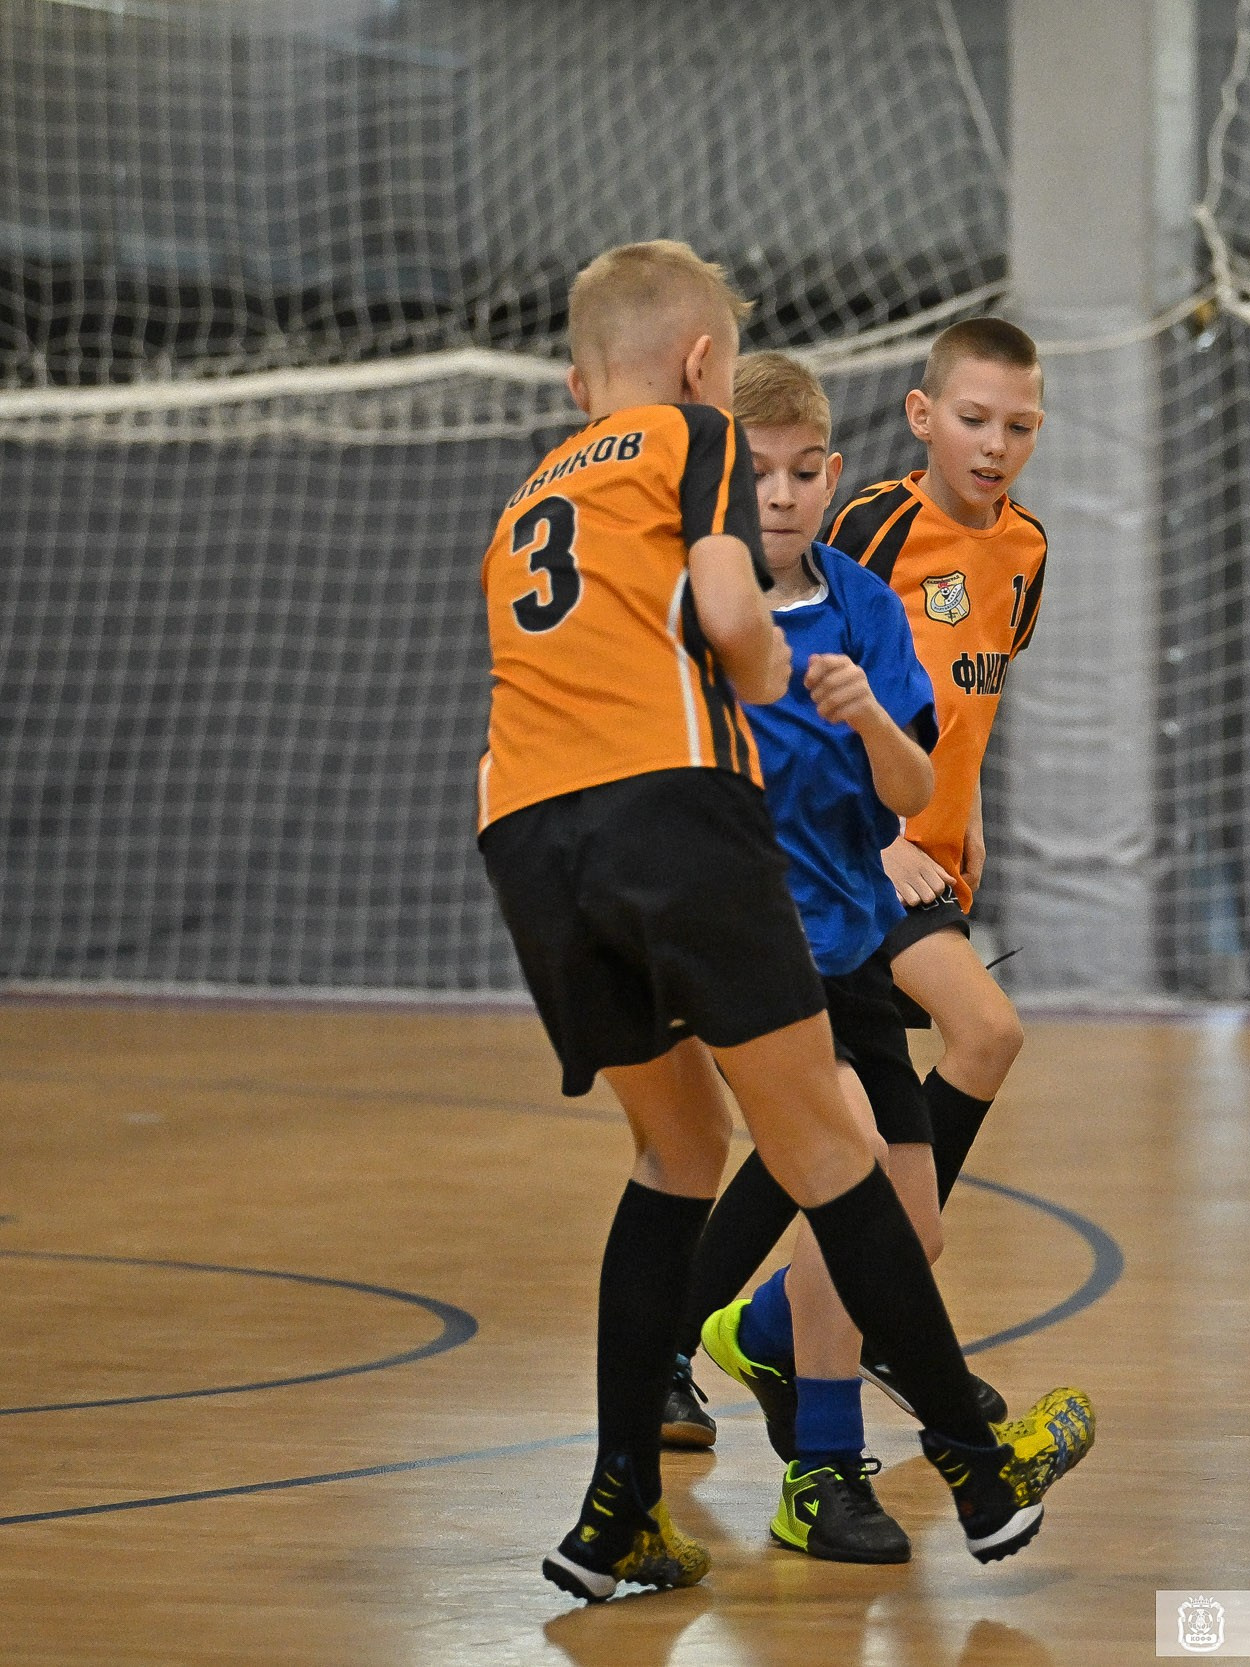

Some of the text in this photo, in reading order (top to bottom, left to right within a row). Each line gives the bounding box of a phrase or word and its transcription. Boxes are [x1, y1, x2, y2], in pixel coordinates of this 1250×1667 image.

[506, 431, 643, 509] ОВИКОВ
[511, 494, 581, 633] 3
[1009, 573, 1026, 628] 1
